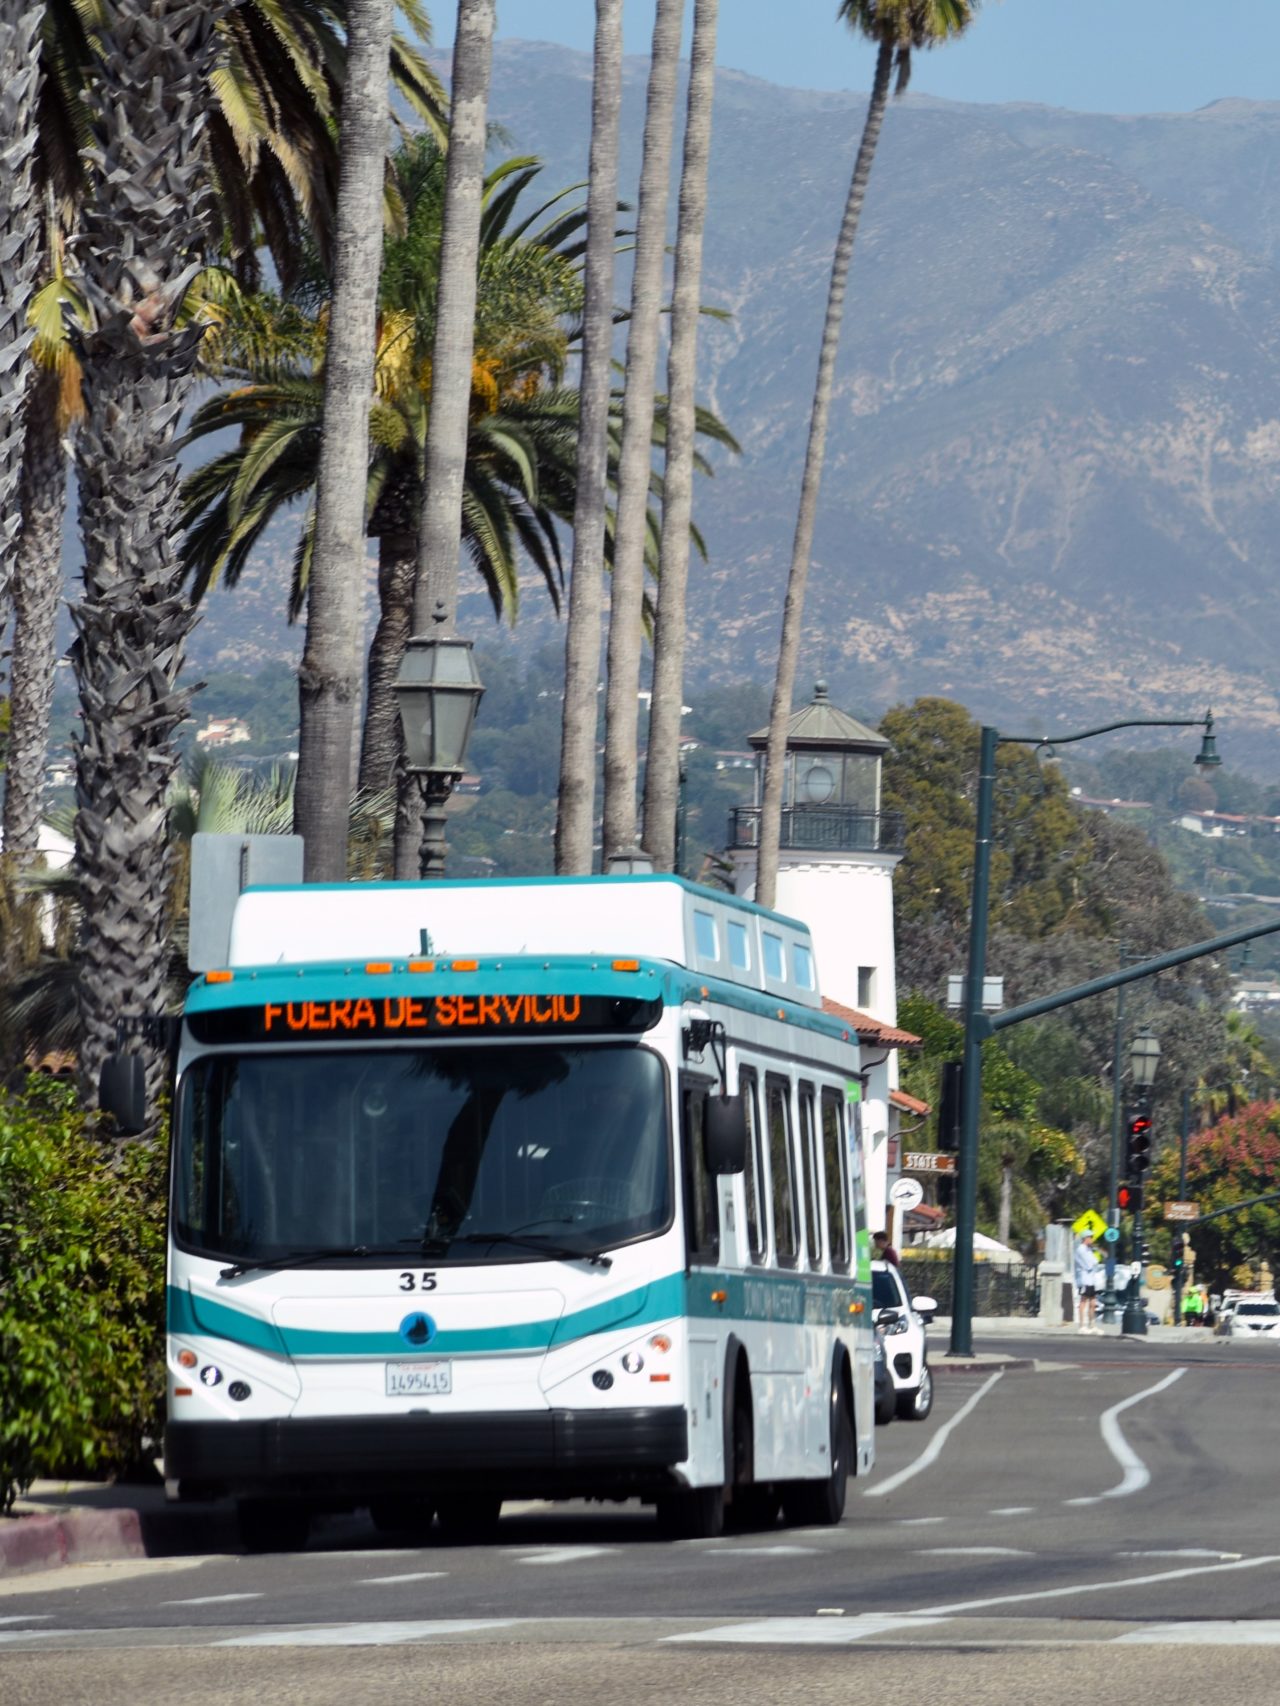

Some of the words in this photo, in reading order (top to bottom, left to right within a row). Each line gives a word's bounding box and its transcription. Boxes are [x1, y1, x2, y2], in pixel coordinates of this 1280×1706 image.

[264, 998, 377, 1031] FUERA
[384, 996, 428, 1028] DE
[906, 1155, 938, 1169] STATE
[399, 1272, 437, 1291] 35
